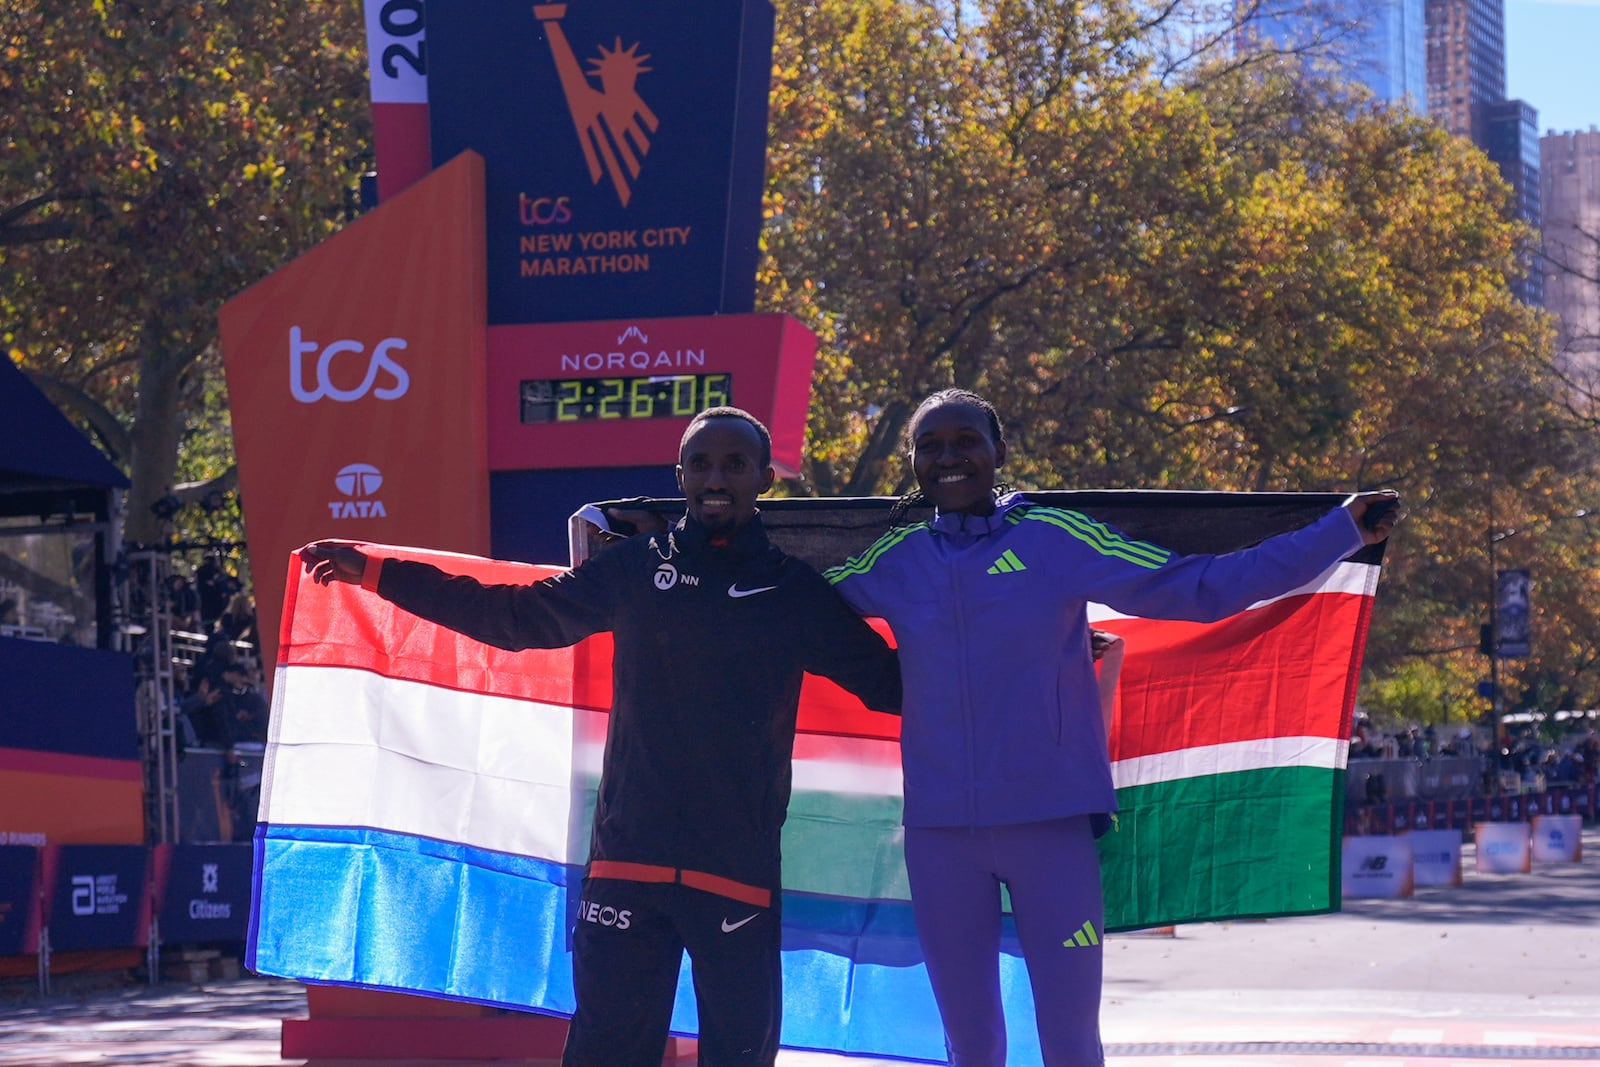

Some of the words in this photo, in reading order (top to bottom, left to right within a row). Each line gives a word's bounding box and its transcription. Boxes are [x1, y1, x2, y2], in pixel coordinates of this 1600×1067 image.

[519, 192, 572, 225] tcs
[520, 235, 573, 254] NEW
[578, 230, 637, 250] YORK
[642, 227, 692, 247] CITY
[520, 253, 650, 277] MARATHON
[290, 325, 410, 403] tcs
[561, 349, 706, 371] NORQAIN
[328, 501, 388, 519] TATA
[680, 574, 700, 587] NN
[577, 900, 633, 930] NEOS
